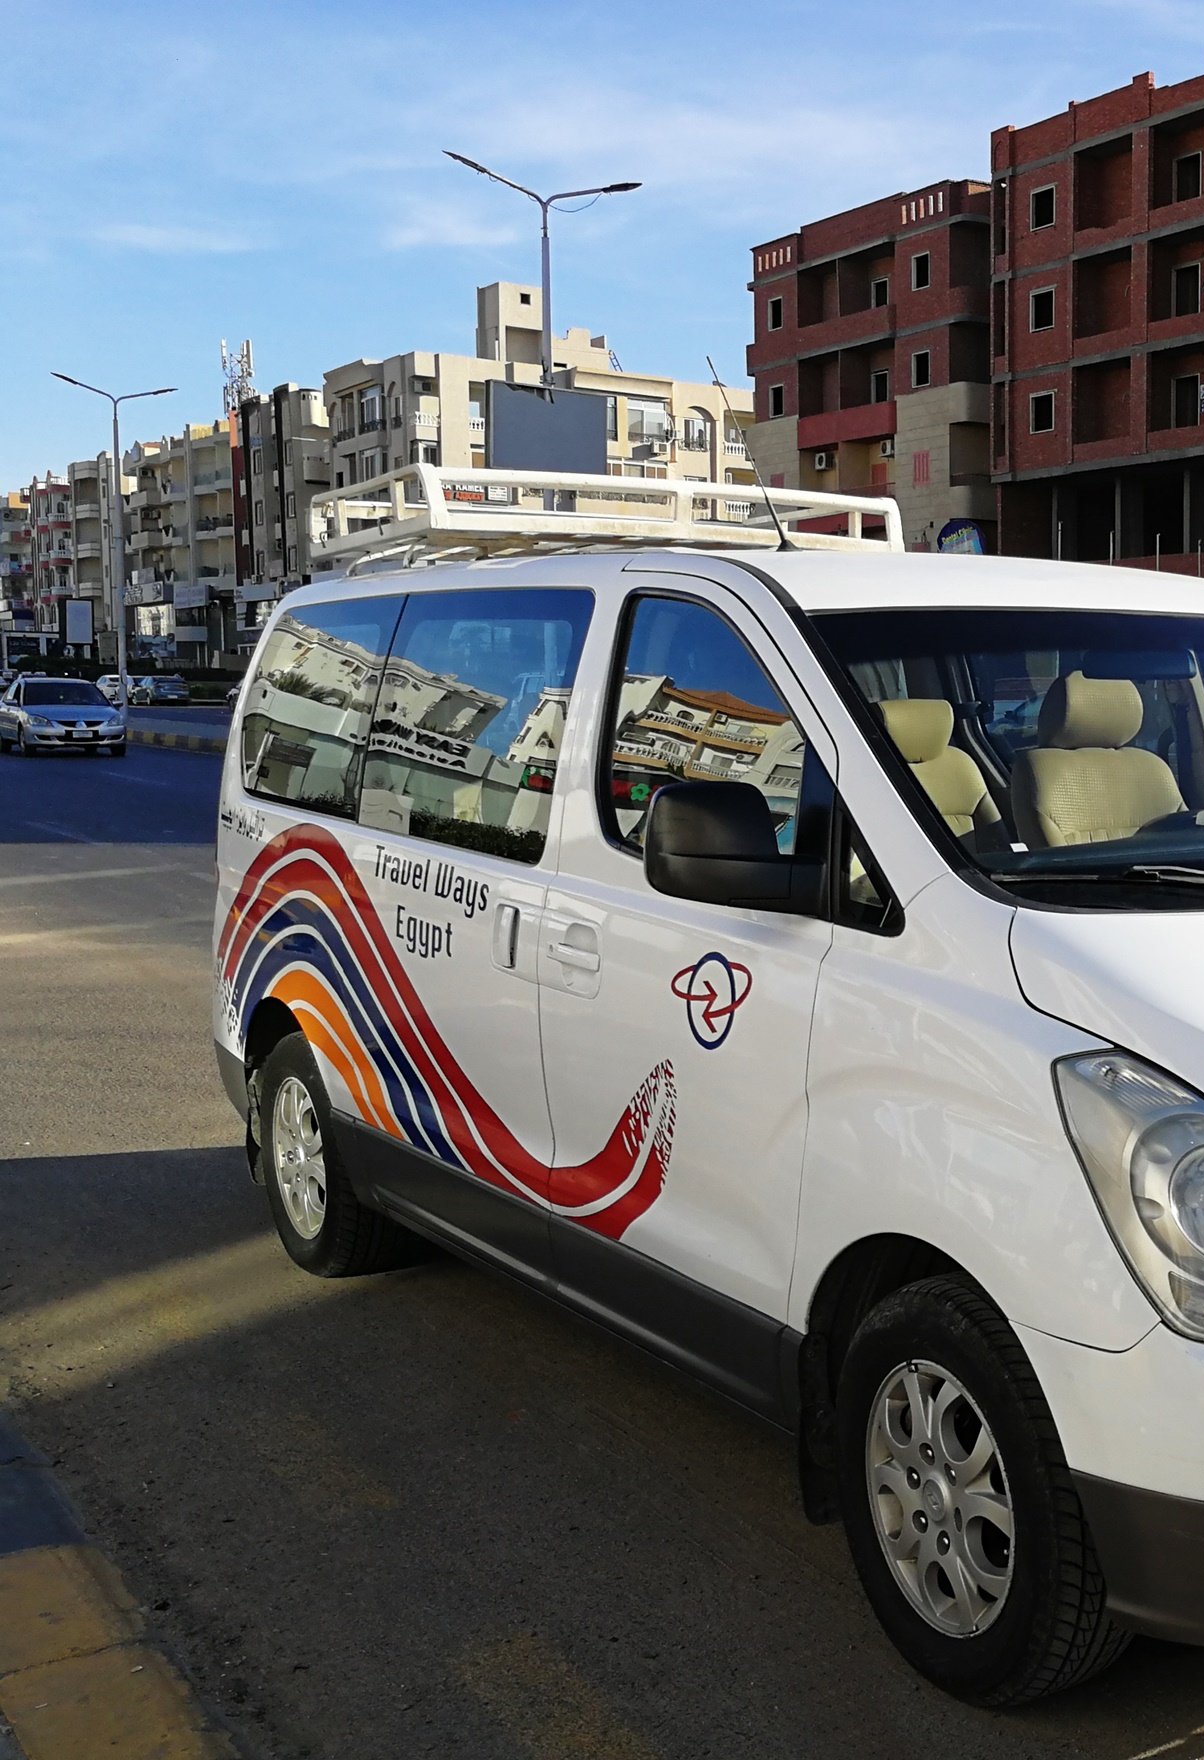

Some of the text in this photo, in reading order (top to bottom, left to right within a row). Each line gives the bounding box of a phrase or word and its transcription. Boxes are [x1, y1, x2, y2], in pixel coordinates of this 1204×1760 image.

[375, 844, 490, 919] Travel Ways
[396, 904, 453, 959] Egypt
